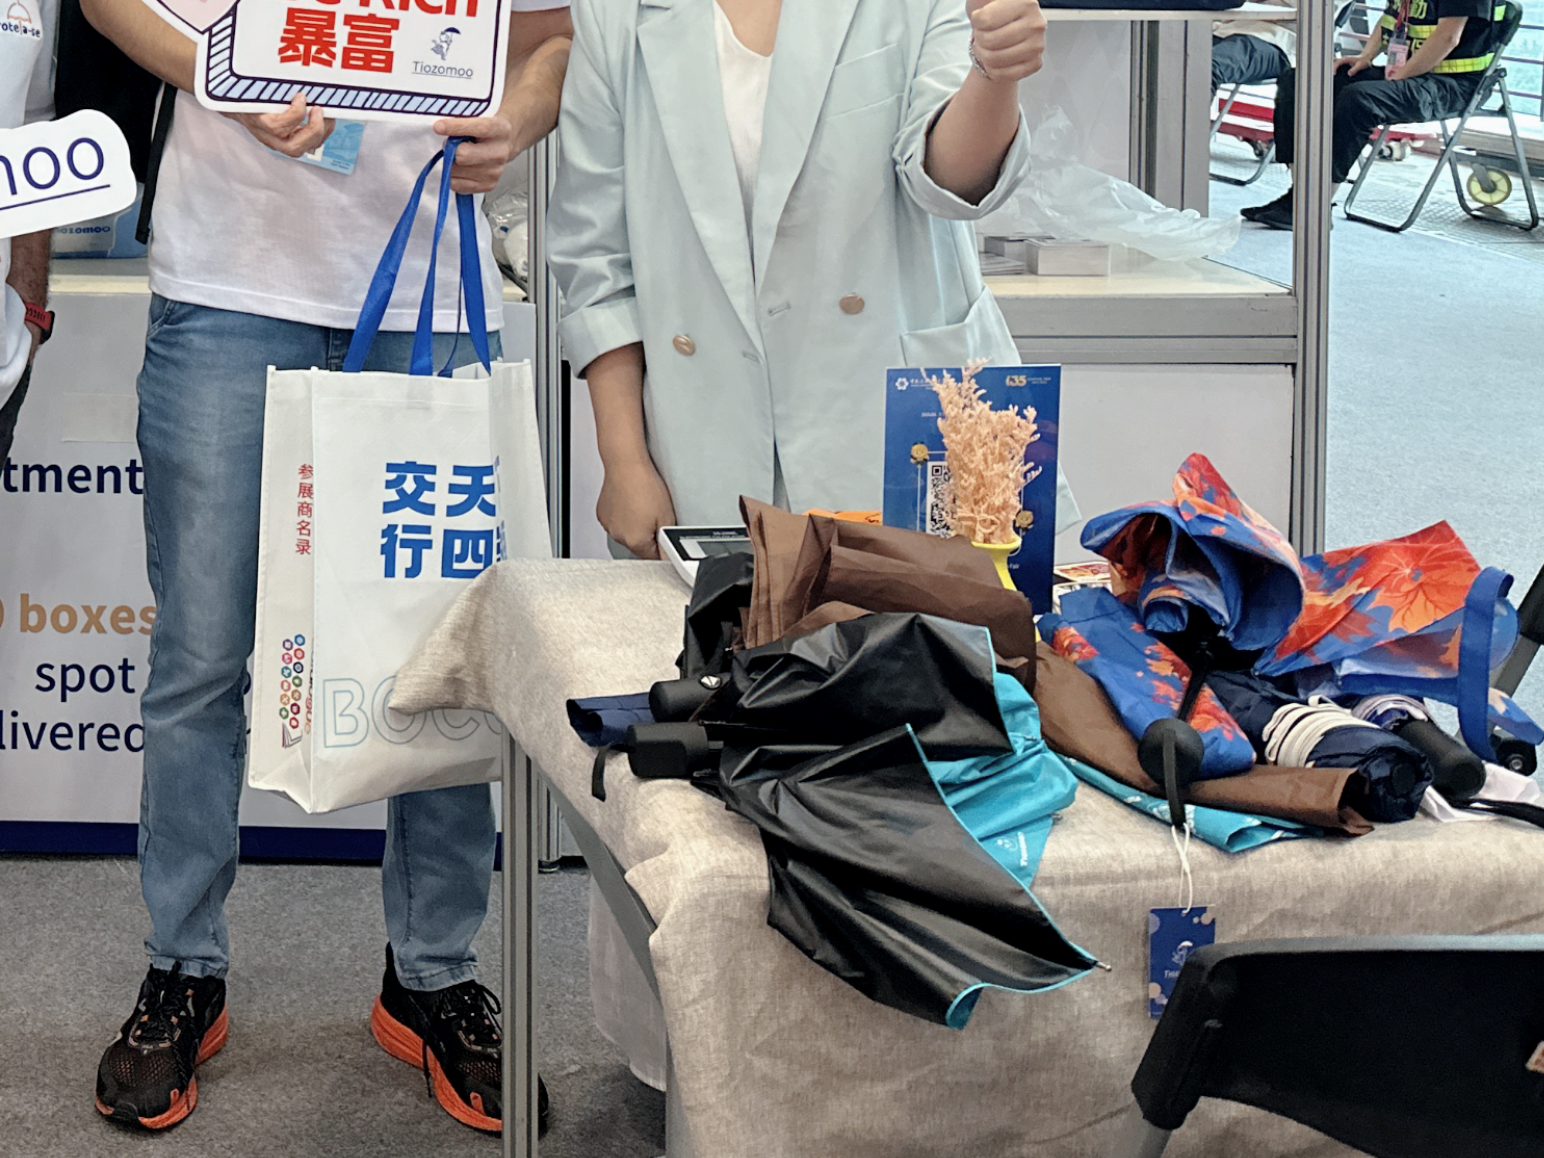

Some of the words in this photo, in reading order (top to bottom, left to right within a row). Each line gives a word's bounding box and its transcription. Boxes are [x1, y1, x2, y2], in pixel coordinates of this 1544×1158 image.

[278, 7, 400, 73] 暴富
[412, 60, 474, 78] Tiozomoo
[20, 593, 156, 635] boxes
[35, 658, 135, 703] spot
